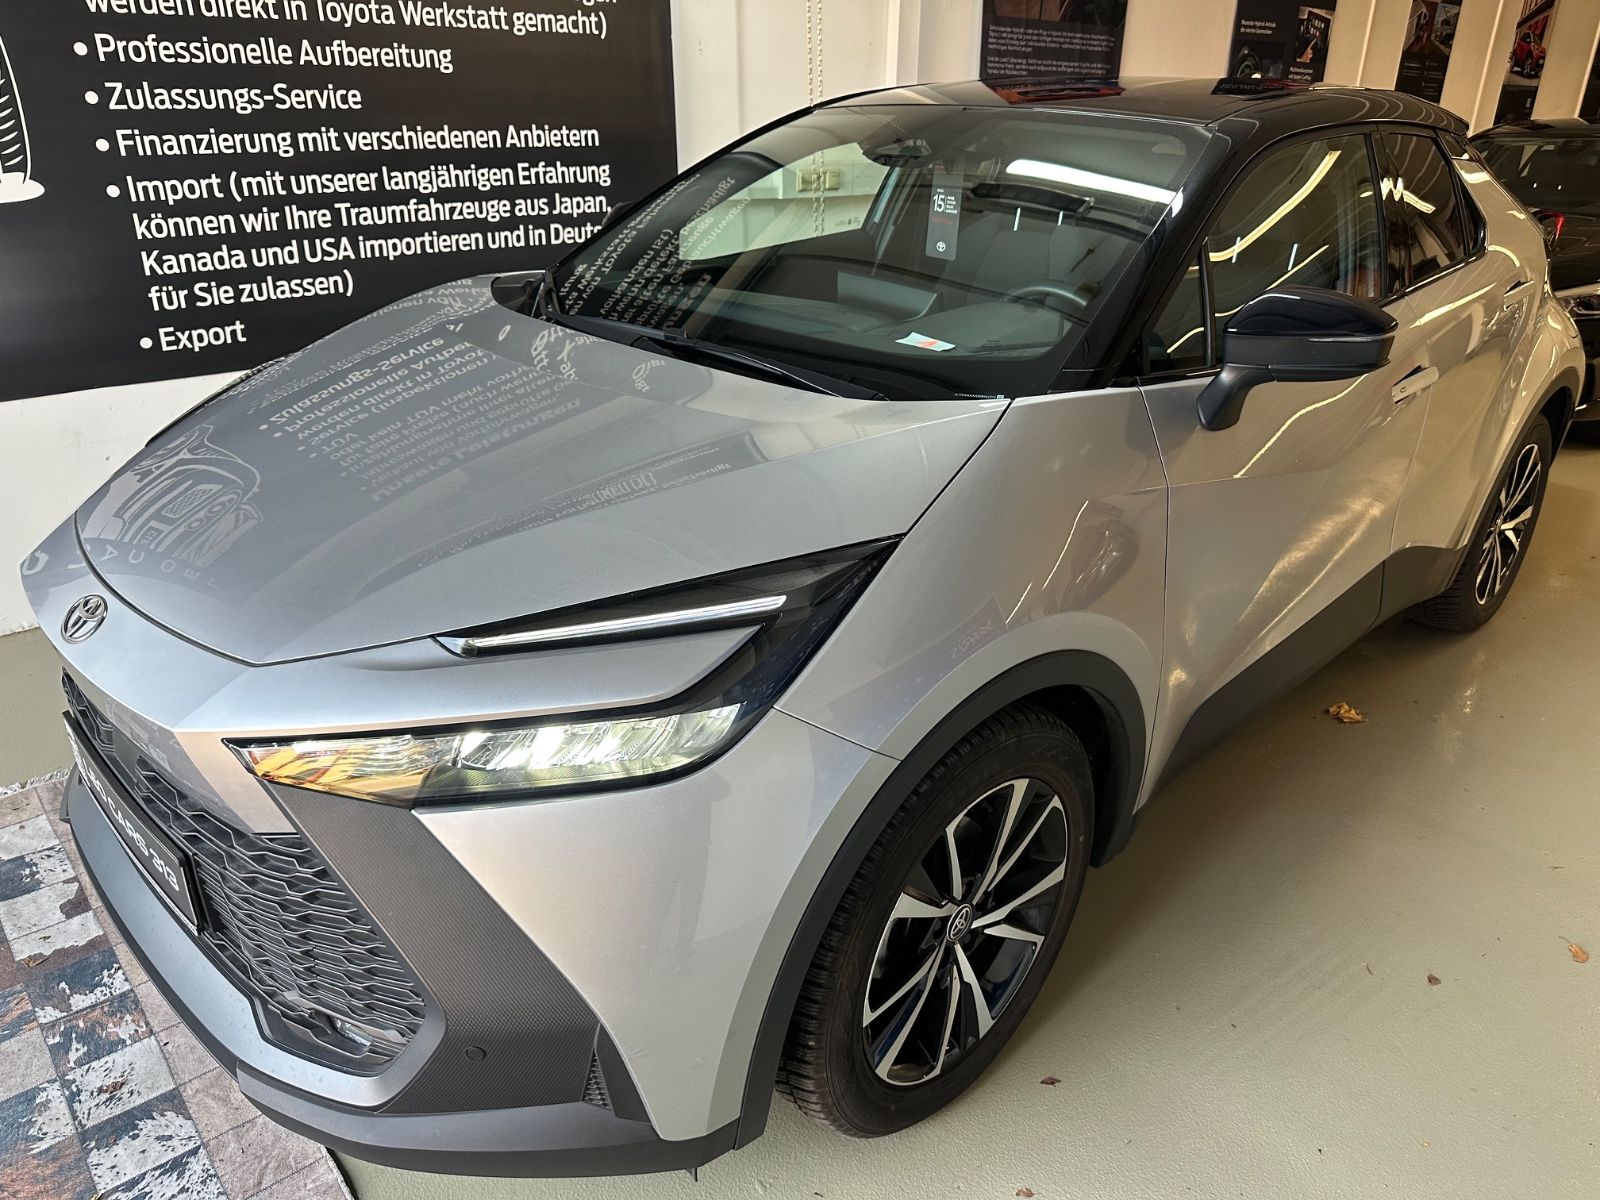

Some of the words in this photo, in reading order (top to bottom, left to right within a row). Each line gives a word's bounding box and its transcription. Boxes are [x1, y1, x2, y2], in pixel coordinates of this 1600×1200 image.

[314, 0, 396, 28] Toyota
[397, 0, 509, 31] Werkstatt
[512, 10, 608, 40] gemacht)
[93, 32, 294, 65] Professionelle
[299, 39, 454, 74] Aufbereitung
[104, 81, 363, 115] Zulassungs-Service
[115, 127, 295, 158] Finanzierung
[297, 126, 341, 152] mit
[343, 124, 502, 151] verschiedenen
[505, 123, 601, 149] Anbietern
[126, 173, 225, 206] Import
[229, 170, 287, 203] (mit
[289, 170, 379, 195] unserer
[381, 164, 515, 194] langjährigen
[517, 160, 612, 187] Erfahrung
[932, 193, 946, 213] 15
[132, 212, 237, 240] können
[240, 206, 280, 233] wir
[284, 204, 332, 231] Ihre
[333, 197, 513, 228] Traumfahrzeuge
[514, 196, 549, 217] aus
[552, 192, 612, 220] Japan,
[140, 244, 248, 277] Kanada
[250, 239, 300, 268] und
[302, 235, 356, 264] USA
[358, 230, 484, 261] importieren
[487, 224, 525, 249] und
[528, 224, 547, 247] in
[148, 284, 189, 312] für
[193, 281, 235, 308] Sie
[238, 268, 354, 303] zulassen)
[158, 319, 247, 352] Export
